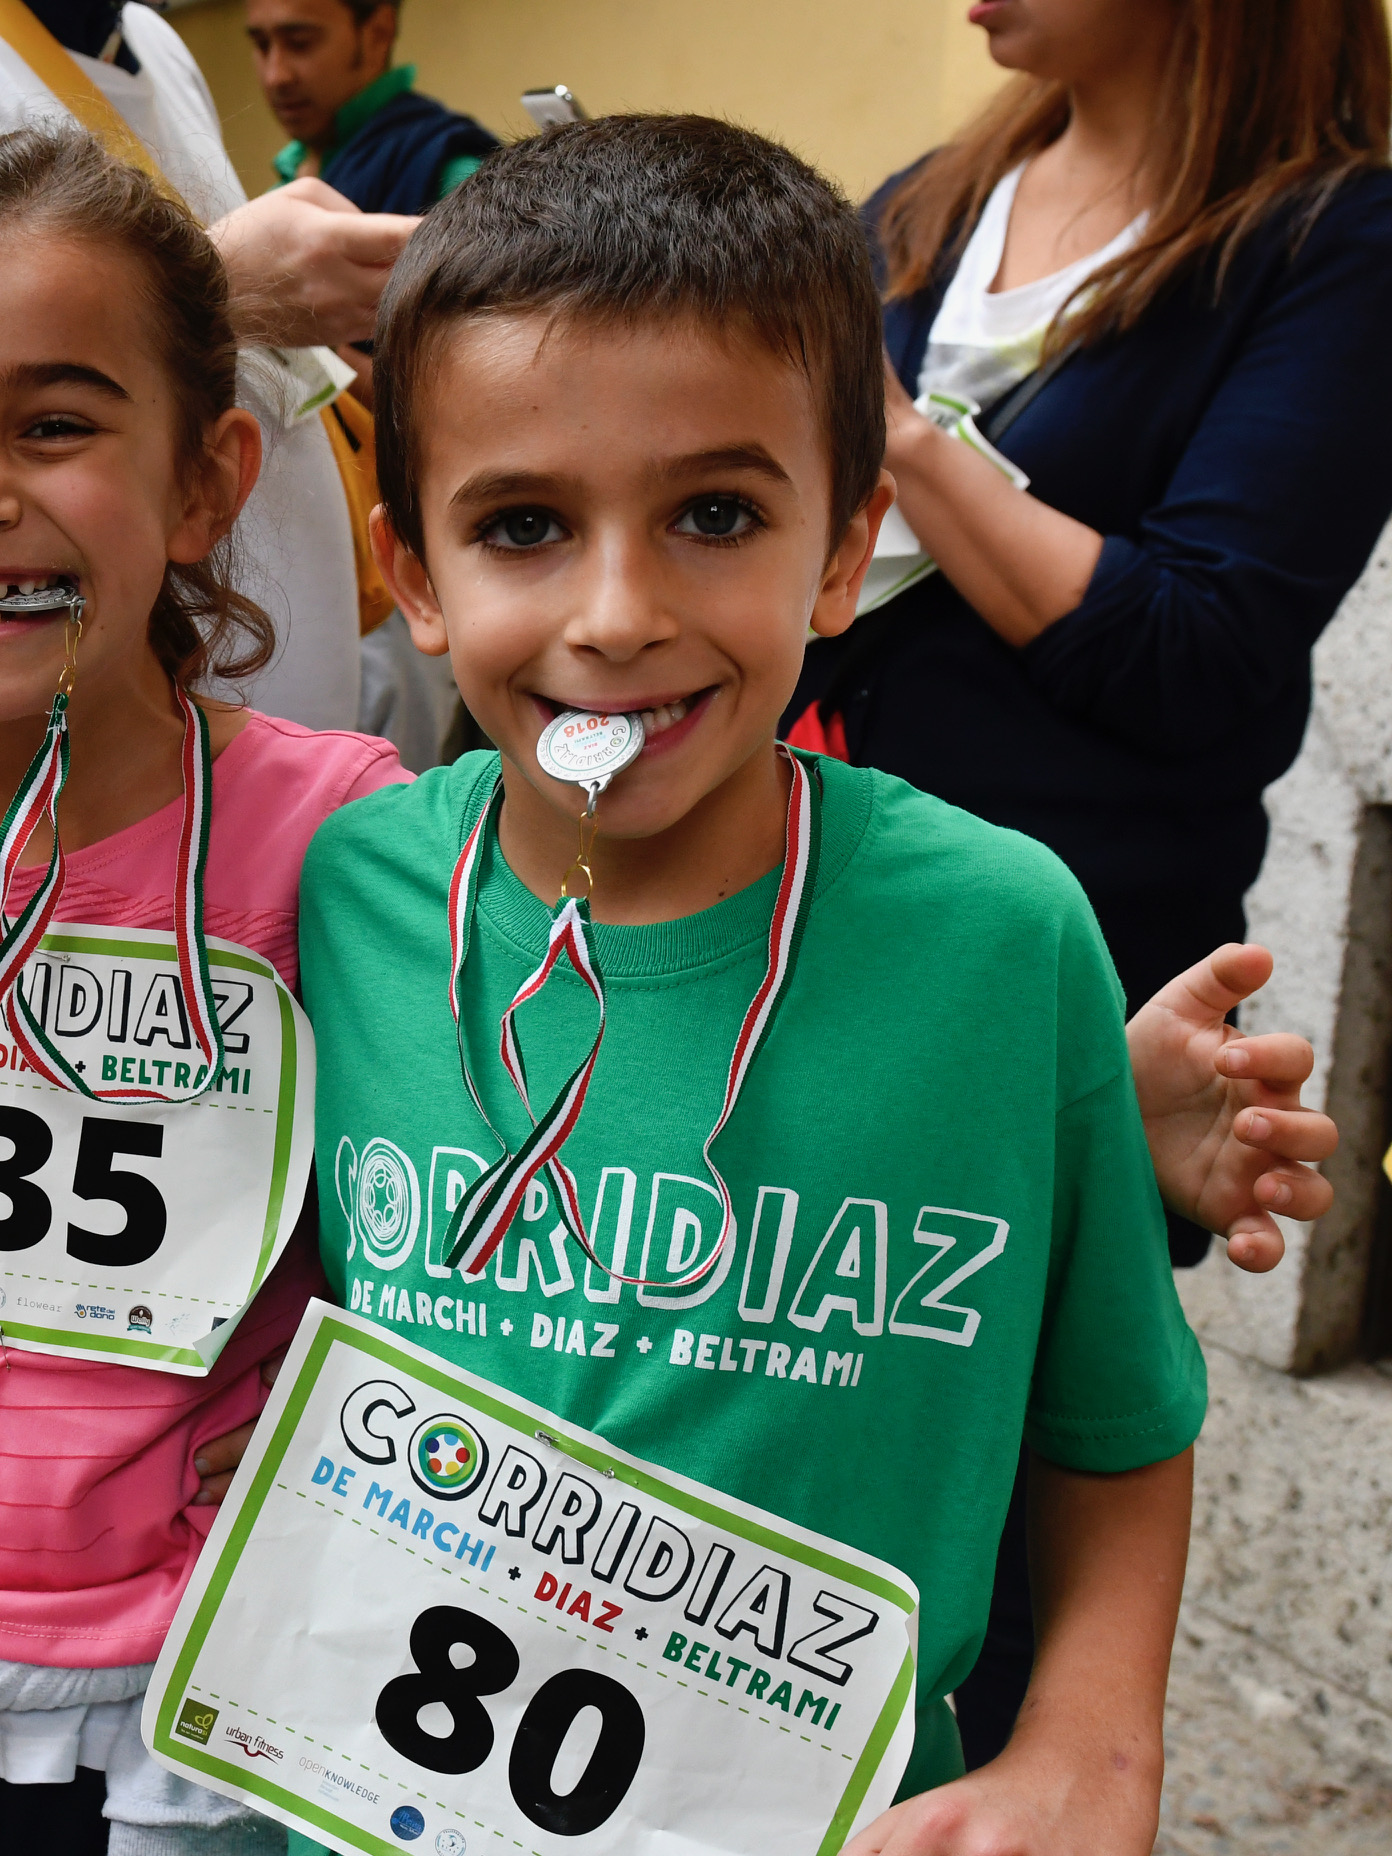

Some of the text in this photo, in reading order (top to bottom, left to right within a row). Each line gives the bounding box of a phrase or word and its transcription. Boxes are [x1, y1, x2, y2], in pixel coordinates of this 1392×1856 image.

[102, 1055, 251, 1094] BELTRAMI
[17, 1297, 62, 1313] flowear
[351, 1277, 374, 1314] DE
[378, 1284, 487, 1337] MARCHI
[530, 1311, 617, 1359] DIAZ
[671, 1329, 864, 1387] BELTRAMI
[340, 1380, 877, 1687] CORRIDIAZ
[310, 1456, 350, 1498] DE
[364, 1480, 497, 1574] MARCHI
[533, 1571, 622, 1633] DIAZ
[662, 1630, 841, 1731] BELTRAMI
[226, 1726, 252, 1744] urban
[254, 1736, 284, 1759] fitness
[375, 1605, 646, 1837] 80
[298, 1756, 380, 1805] openKNOWLEDGE
